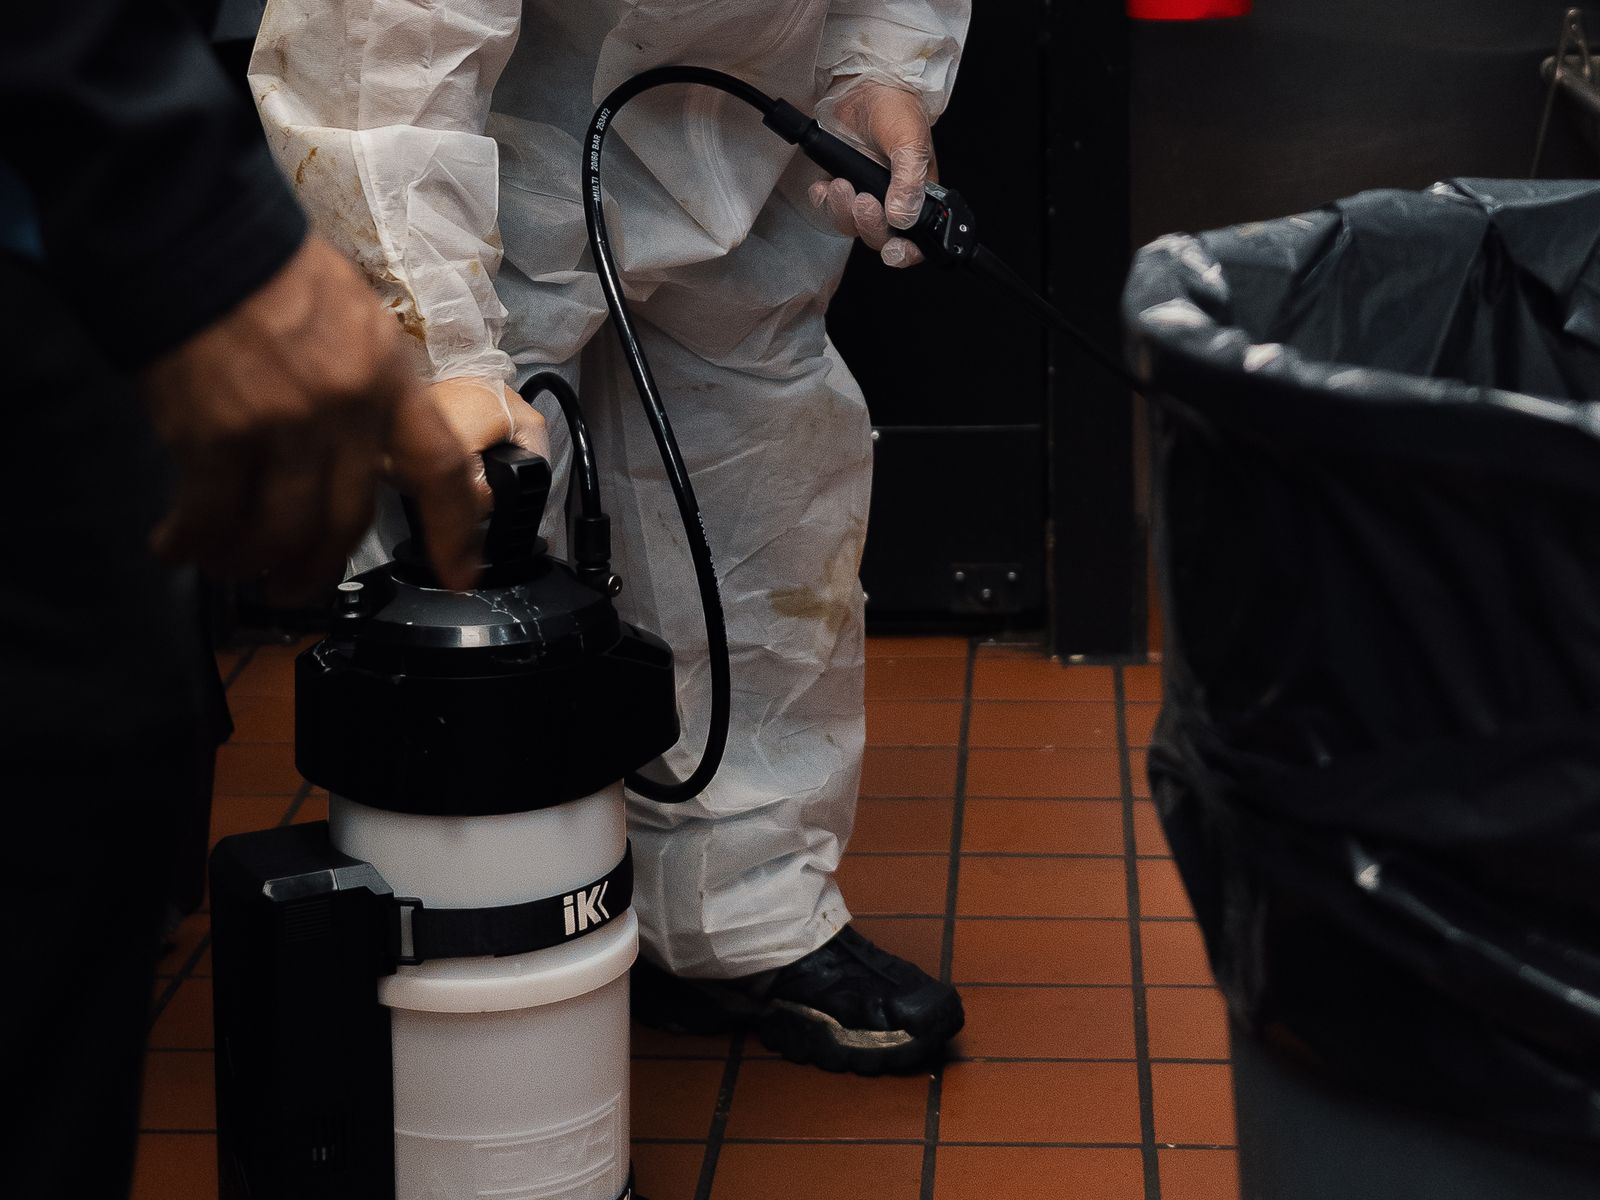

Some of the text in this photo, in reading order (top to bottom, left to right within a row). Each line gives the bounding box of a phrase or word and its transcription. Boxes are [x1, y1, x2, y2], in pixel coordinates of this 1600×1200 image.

[595, 107, 611, 131] 253472
[591, 134, 601, 150] BAR
[592, 176, 601, 202] MULTI
